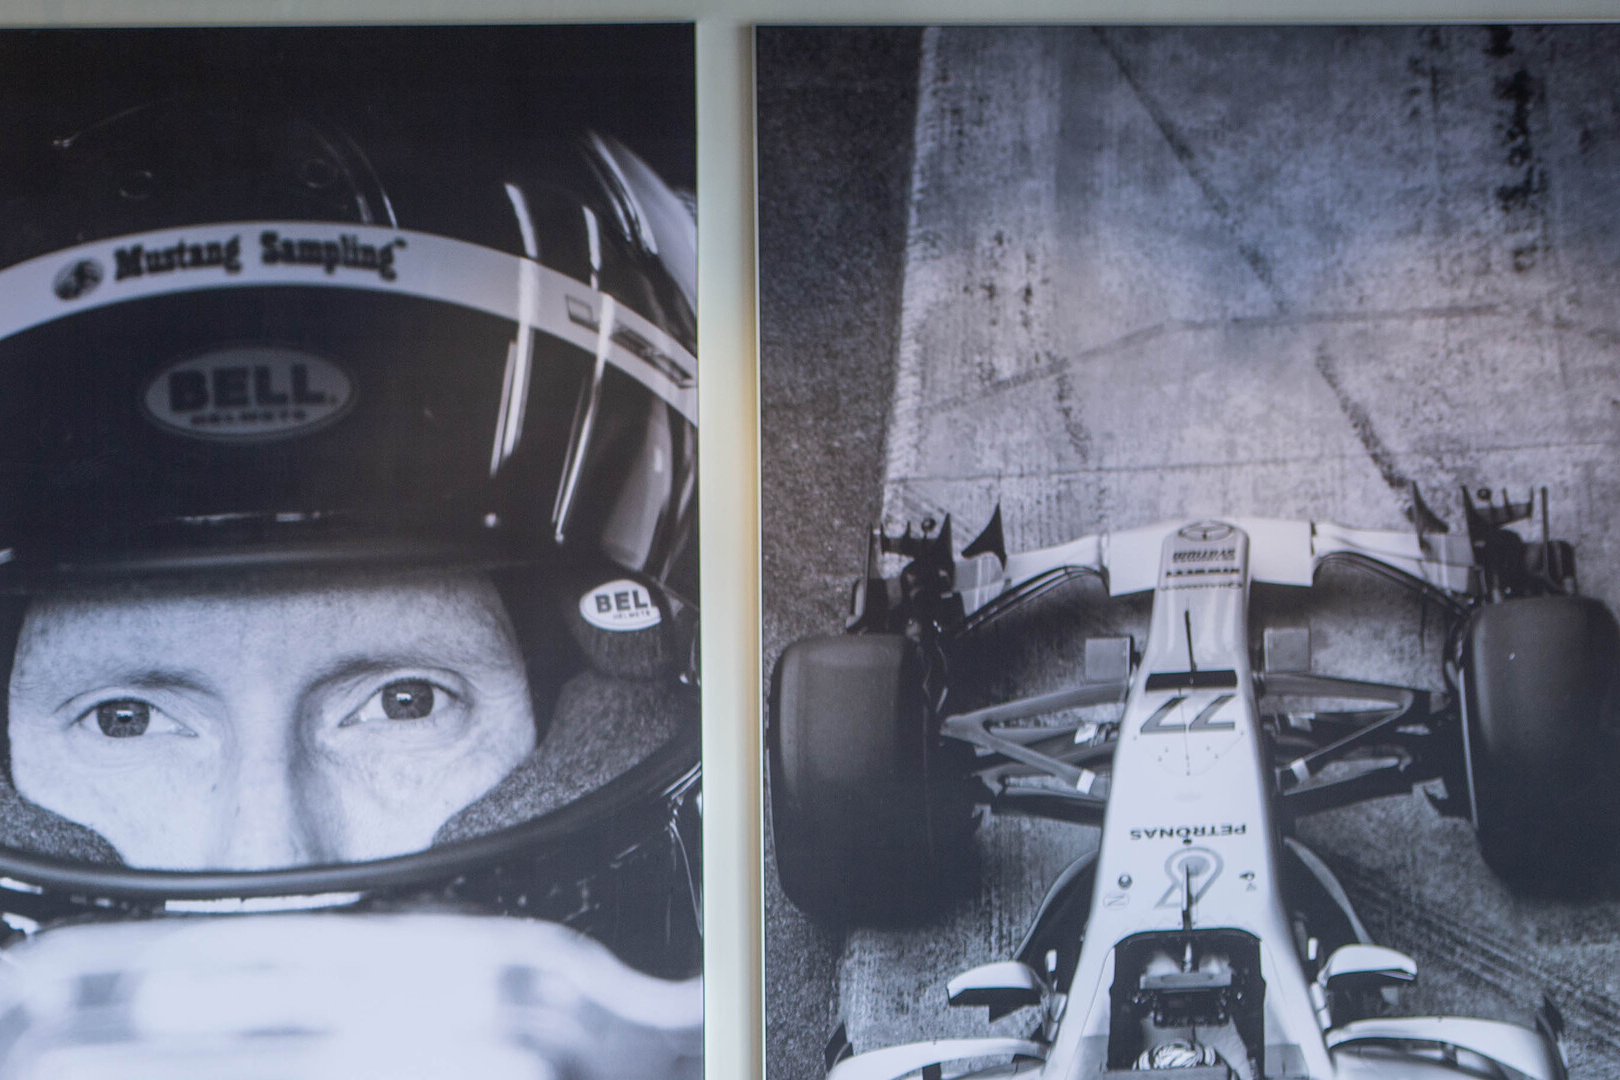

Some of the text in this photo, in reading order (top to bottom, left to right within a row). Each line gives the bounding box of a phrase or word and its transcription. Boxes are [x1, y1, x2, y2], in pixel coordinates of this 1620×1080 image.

[114, 231, 397, 282] Mustang Sampling
[168, 362, 328, 414] BELL
[1130, 823, 1247, 841] PETRONAS
